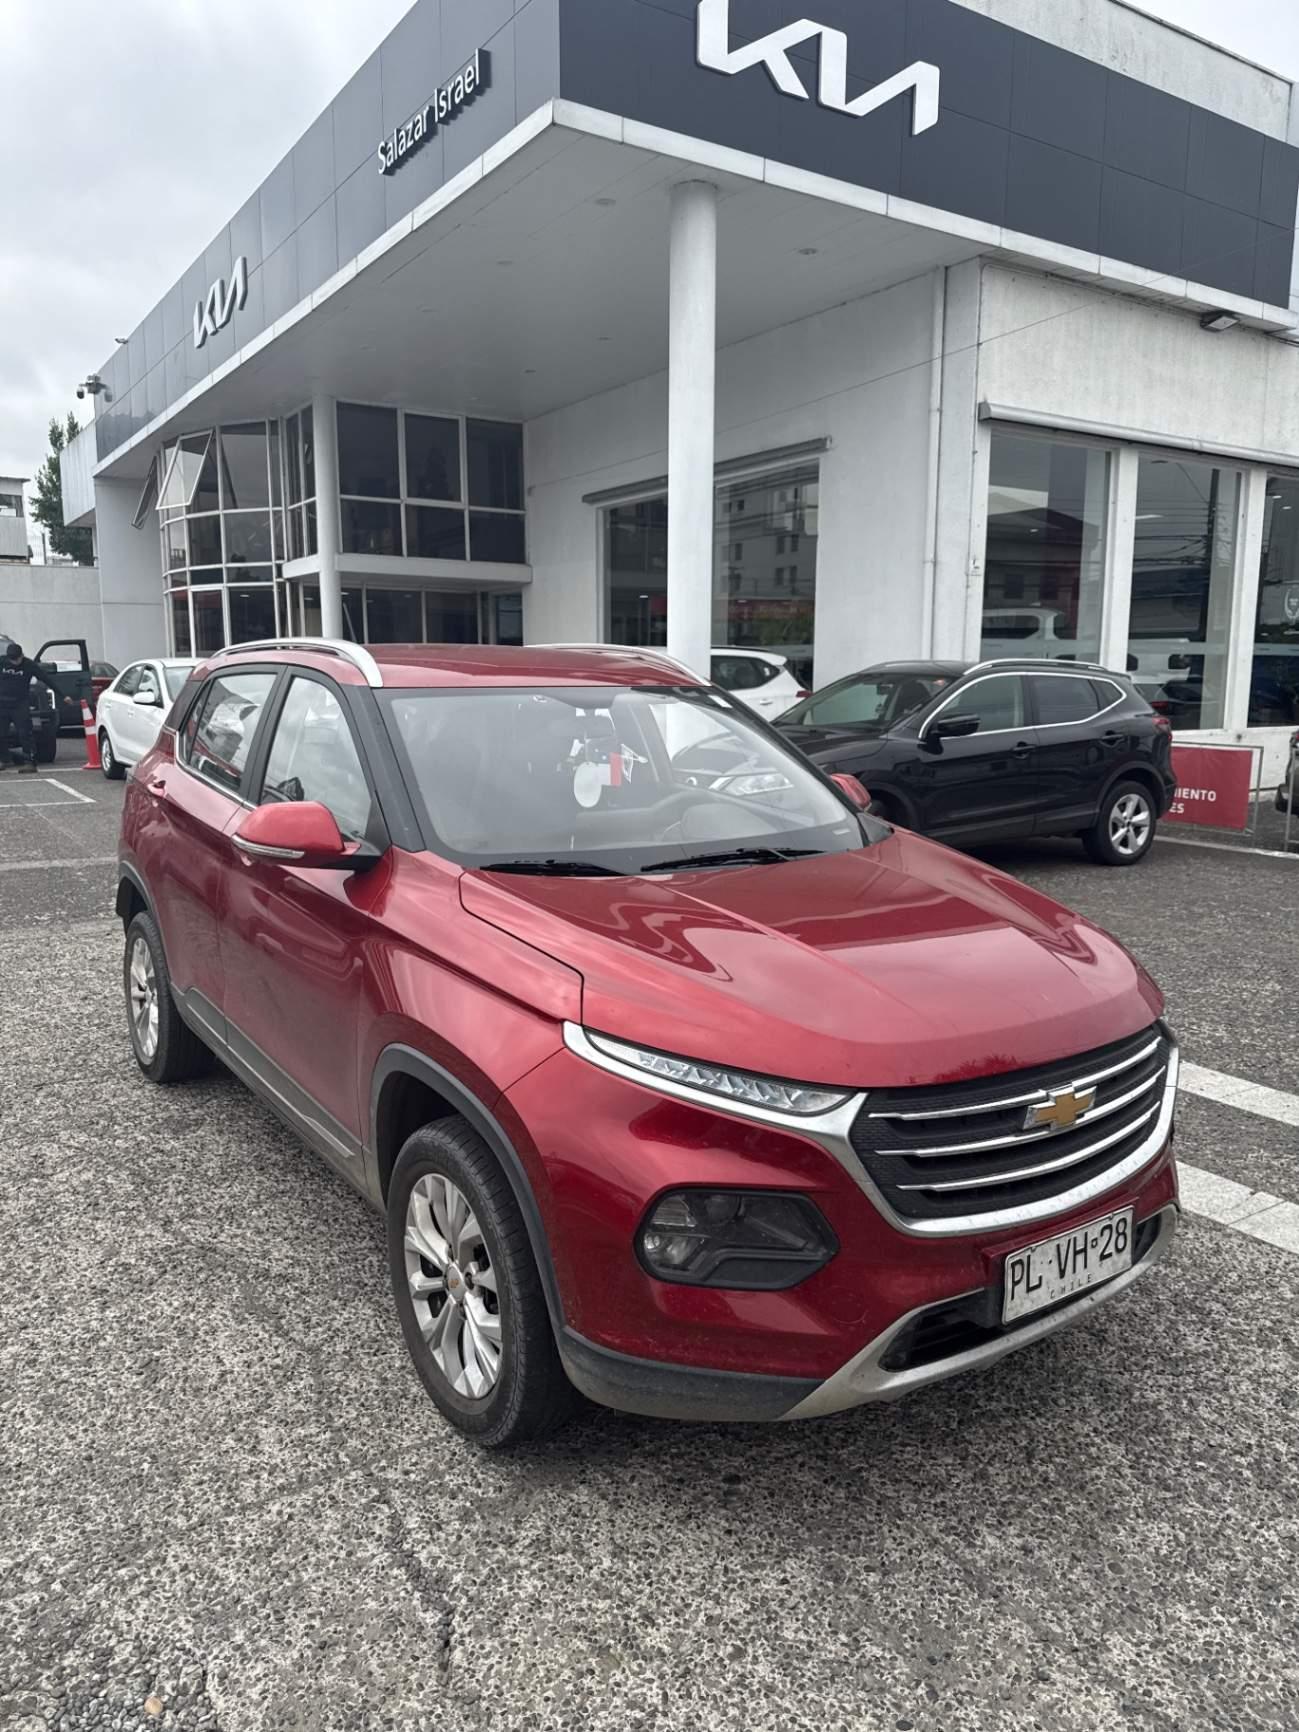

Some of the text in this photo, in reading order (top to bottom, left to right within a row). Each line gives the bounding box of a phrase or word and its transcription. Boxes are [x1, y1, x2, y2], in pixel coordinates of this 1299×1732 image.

[377, 47, 481, 175] Salazar Israel
[696, 0, 941, 136] KIA
[193, 255, 245, 348] KIA
[1050, 1273, 1093, 1300] CHILE
